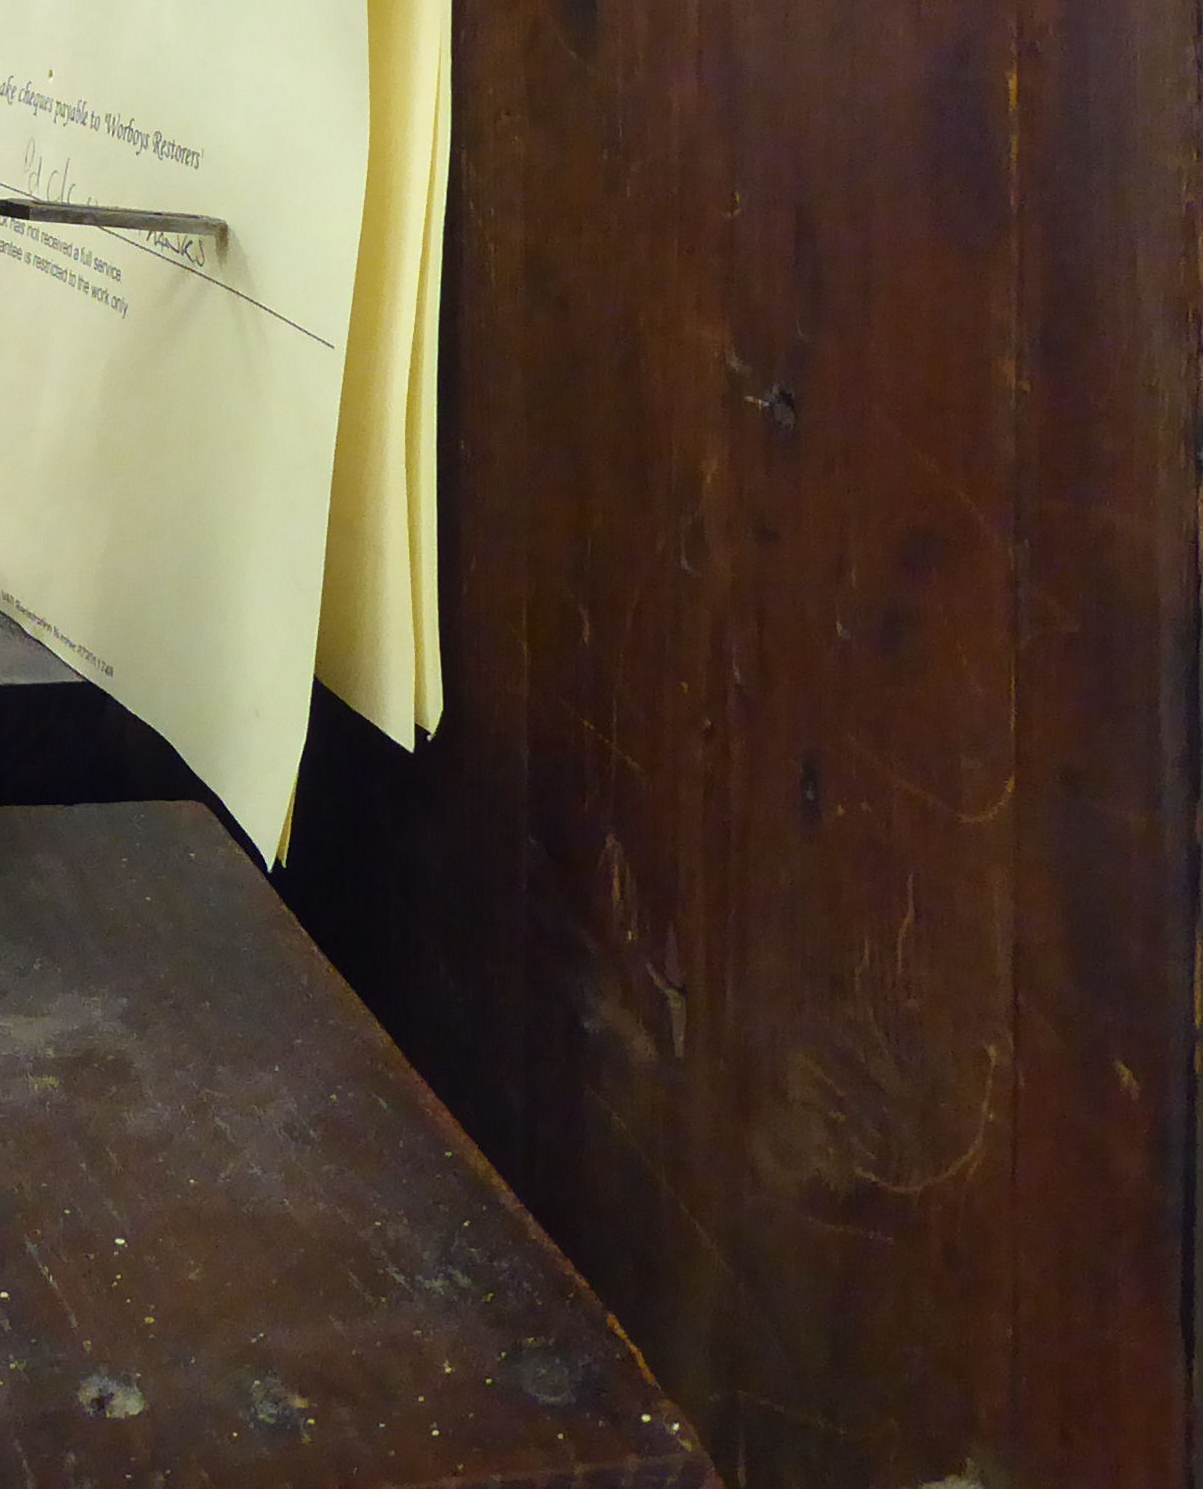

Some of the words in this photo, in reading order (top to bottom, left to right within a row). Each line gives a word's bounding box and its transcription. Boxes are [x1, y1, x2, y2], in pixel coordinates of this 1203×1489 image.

[17, 81, 55, 116] cheques
[53, 99, 89, 128] payable
[90, 110, 102, 132] to
[26, 224, 40, 242] not
[40, 230, 74, 258] received
[73, 248, 79, 261] a
[79, 246, 93, 267] full
[24, 250, 33, 265] is
[33, 254, 69, 284] restricted
[68, 269, 77, 288] to
[77, 276, 90, 296] the
[90, 284, 110, 307] work
[110, 294, 129, 320] only
